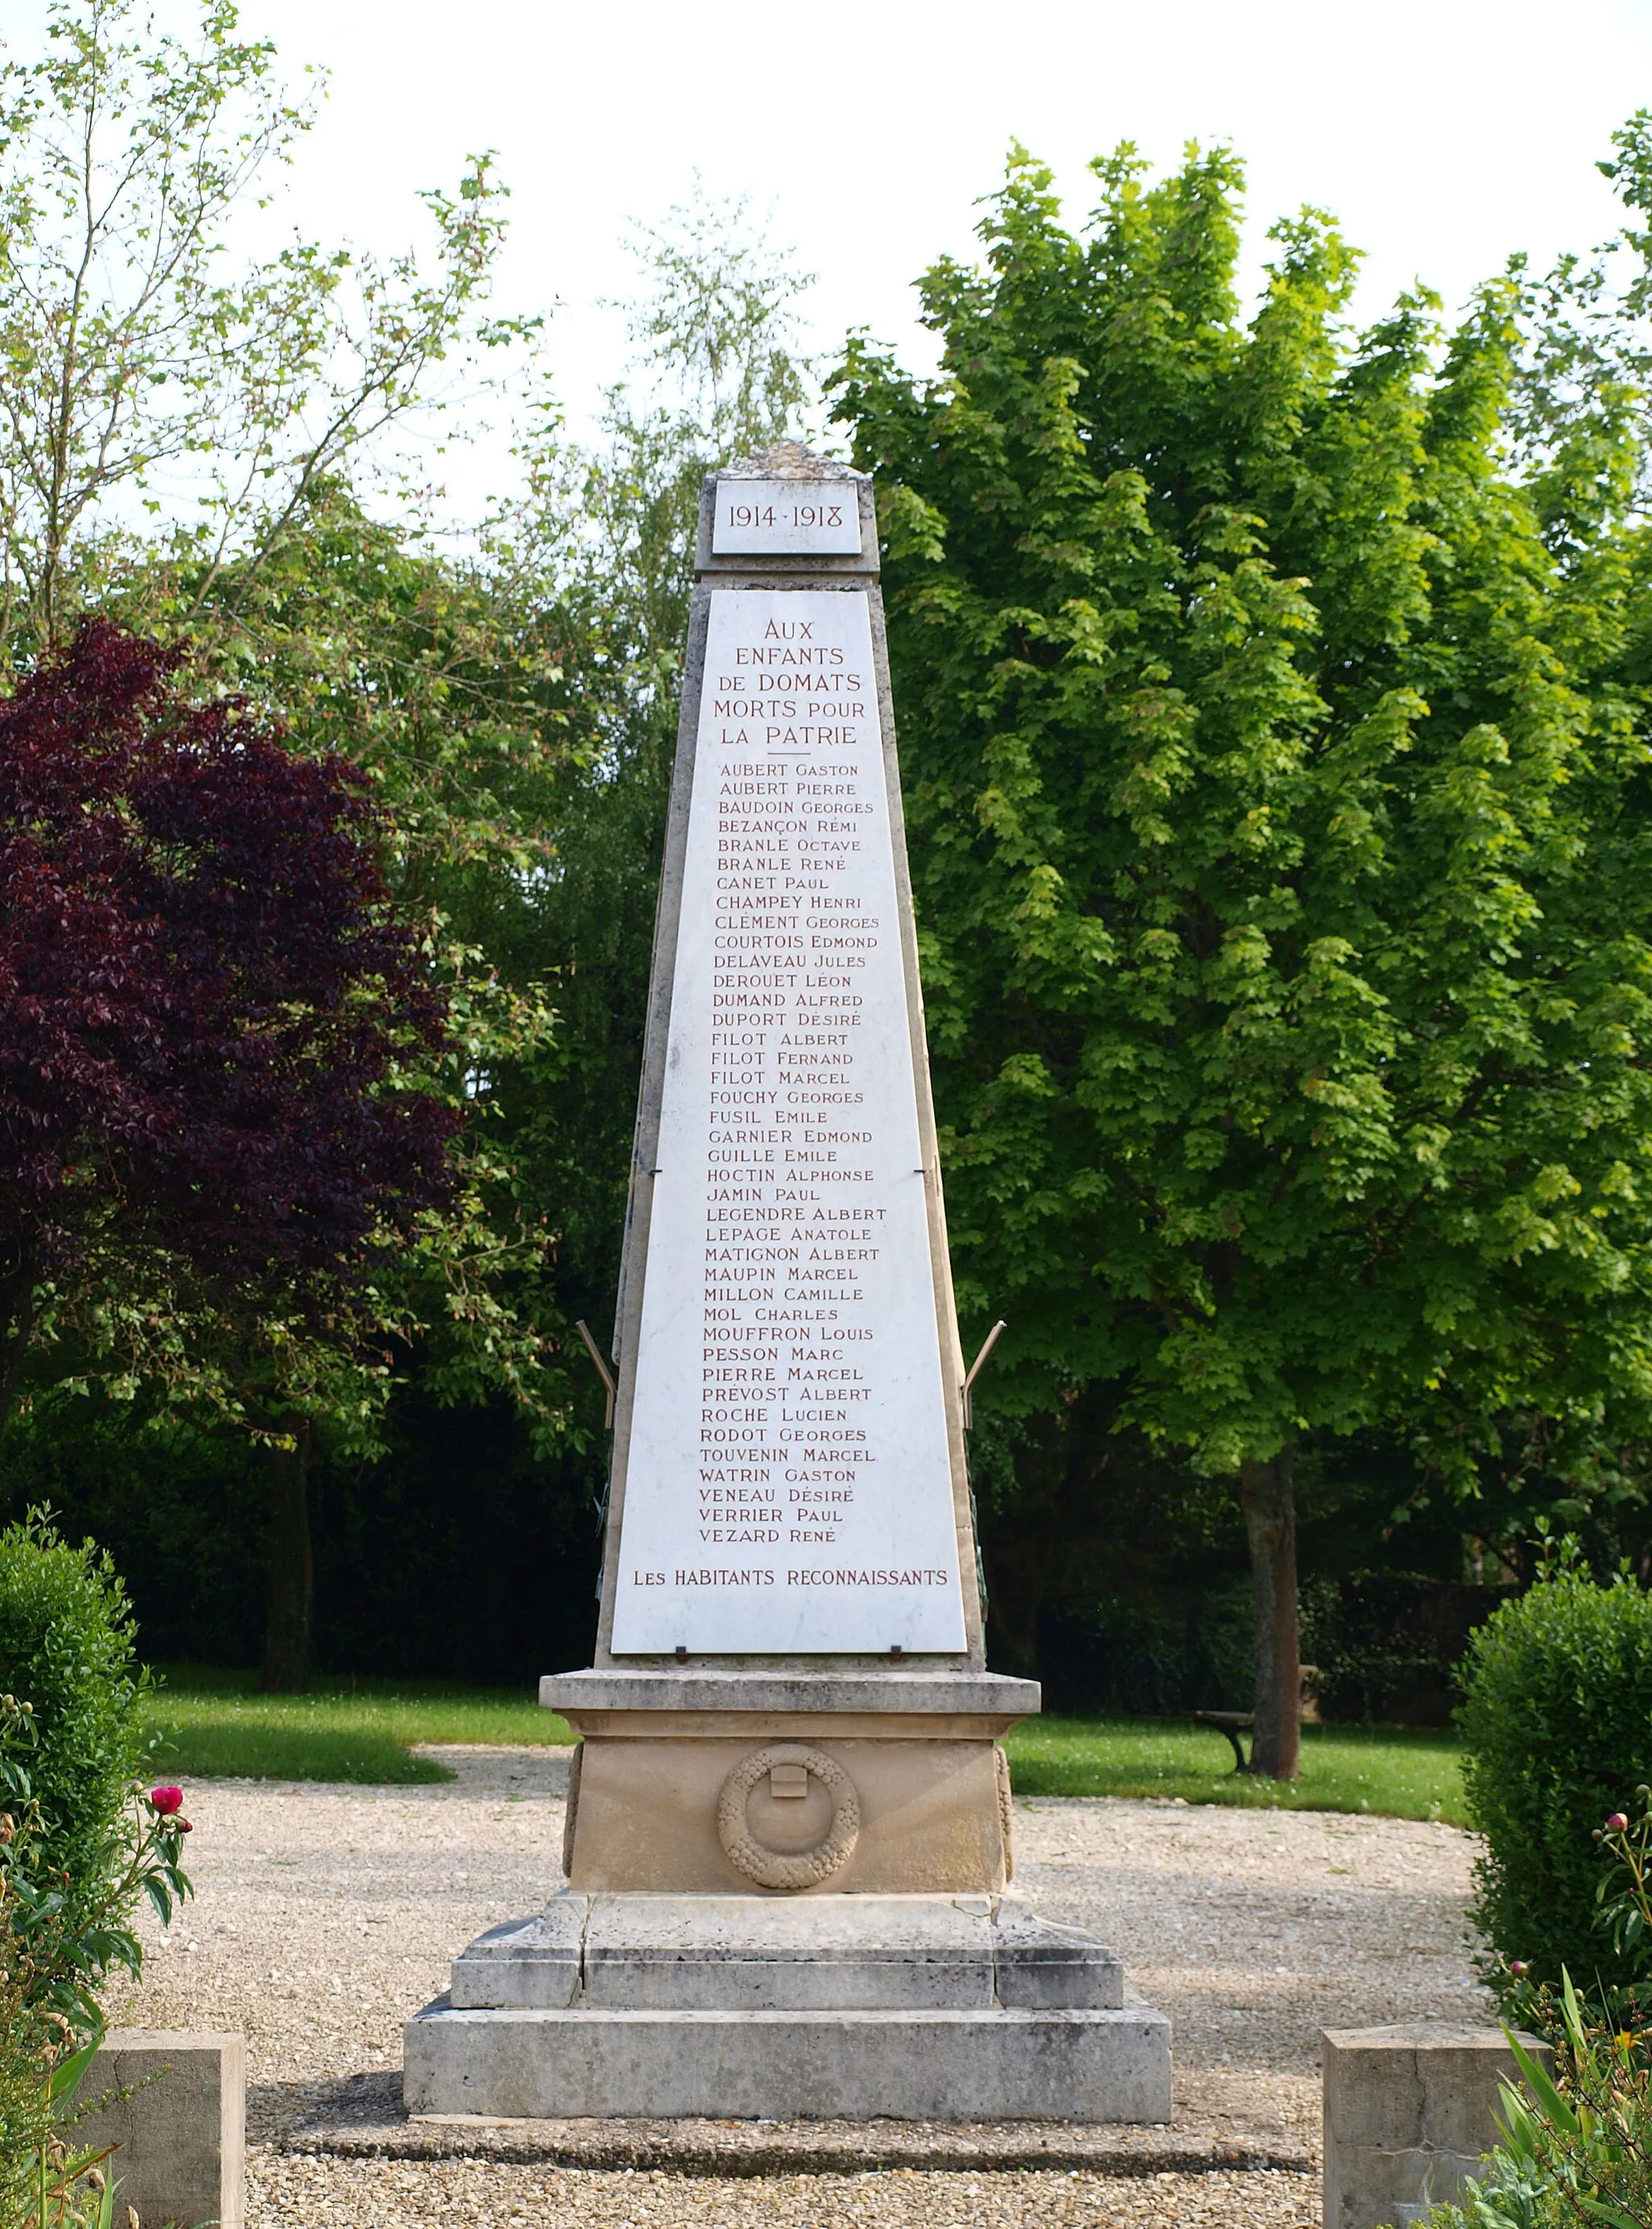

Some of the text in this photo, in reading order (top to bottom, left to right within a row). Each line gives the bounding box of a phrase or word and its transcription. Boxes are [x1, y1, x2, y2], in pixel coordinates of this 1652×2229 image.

[765, 619, 814, 639] AUX
[736, 648, 843, 665] ENFANTS
[720, 674, 860, 691] DE DOMATS
[715, 700, 864, 718] MORTS POUR
[722, 727, 856, 745] LA PATRIE
[721, 764, 857, 776] AUBERT GASTON
[720, 783, 856, 795] AUBERT PIERRE
[720, 802, 873, 813] BAUDOIN GEORGES
[719, 840, 860, 852] BRANLE OCTAVE
[718, 858, 791, 870] BRANLE
[717, 878, 828, 889] CANET PAUL
[716, 896, 860, 909] CHAMPEY HENRI
[807, 916, 878, 929] GEORGES
[715, 936, 877, 948] COURTOIS EDMOND
[715, 954, 865, 968] DELAVEAU JULES
[714, 975, 797, 987] DEROUET
[714, 994, 862, 1007] DUMAND ALFRED
[713, 1013, 786, 1026] DUPORT
[712, 1033, 848, 1046] FILOT ALBERT
[712, 1052, 853, 1065] FILOT FERNAND
[711, 1071, 849, 1084] FILOT MARCEL
[711, 1092, 863, 1104] FOUCHY GEORGES
[711, 1111, 827, 1123] FUSIL EMILE
[709, 1130, 872, 1142] GARNIER EDMOND
[708, 1150, 836, 1162] GUILLE EMILE
[708, 1169, 874, 1182] HOCTIN ALPHONSE
[707, 1188, 820, 1201] JAMIN PAUL
[707, 1208, 886, 1221] LEGENDRE ALBERT
[707, 1228, 871, 1241] LEPAGE ANATOLE
[706, 1247, 879, 1261] MATIGNON ALBERT
[705, 1267, 857, 1281] MAUPIN MARCEL
[705, 1288, 862, 1300] MILLON CAMILLE
[704, 1309, 837, 1321] MOL CHARLES
[704, 1327, 873, 1341] MOUFFRON LOUIS
[703, 1347, 842, 1361] PESSON MARC
[703, 1368, 863, 1381] PIERRE MARCEL
[800, 1388, 871, 1400] ALBERT
[702, 1409, 845, 1422] ROCHE LUCIEN
[701, 1429, 866, 1442] RODOT GEORGES
[700, 1449, 875, 1462] TOUVENIN MARCEL
[699, 1469, 855, 1482] WATRIN GASTON
[699, 1489, 774, 1502] VENEAU
[699, 1509, 842, 1522] VERRIER PAUL
[699, 1530, 778, 1542] VEZARD
[634, 1570, 947, 1585] LES HABITANTS RECONNAISSANTS
